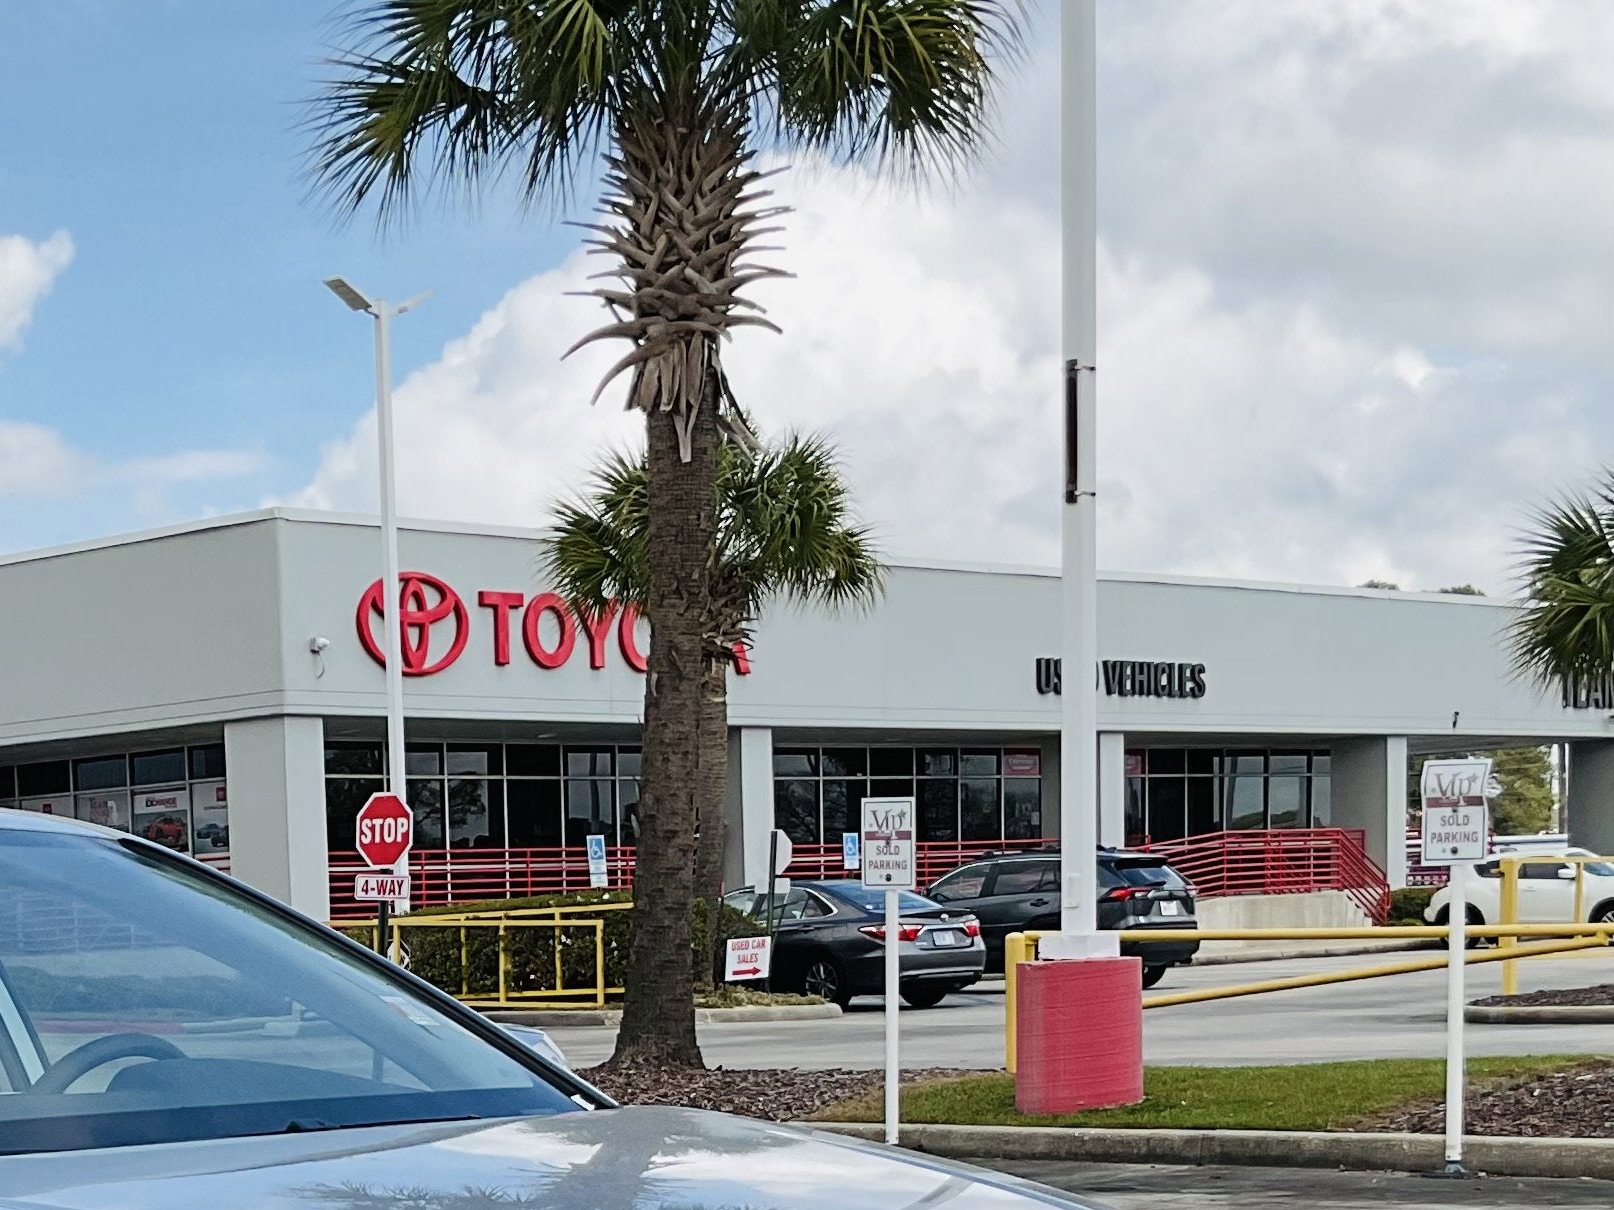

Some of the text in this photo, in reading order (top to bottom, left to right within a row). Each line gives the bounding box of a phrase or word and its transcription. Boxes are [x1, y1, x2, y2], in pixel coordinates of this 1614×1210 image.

[1102, 660, 1206, 699] VEHICLES
[1440, 815, 1470, 827] SOLD
[360, 817, 409, 845] STOP
[1430, 831, 1479, 845] PARKING
[875, 845, 900, 856] SOLD
[868, 860, 908, 870] PARKING
[360, 879, 405, 896] 4-WAY
[732, 939, 766, 951] USED CAR
